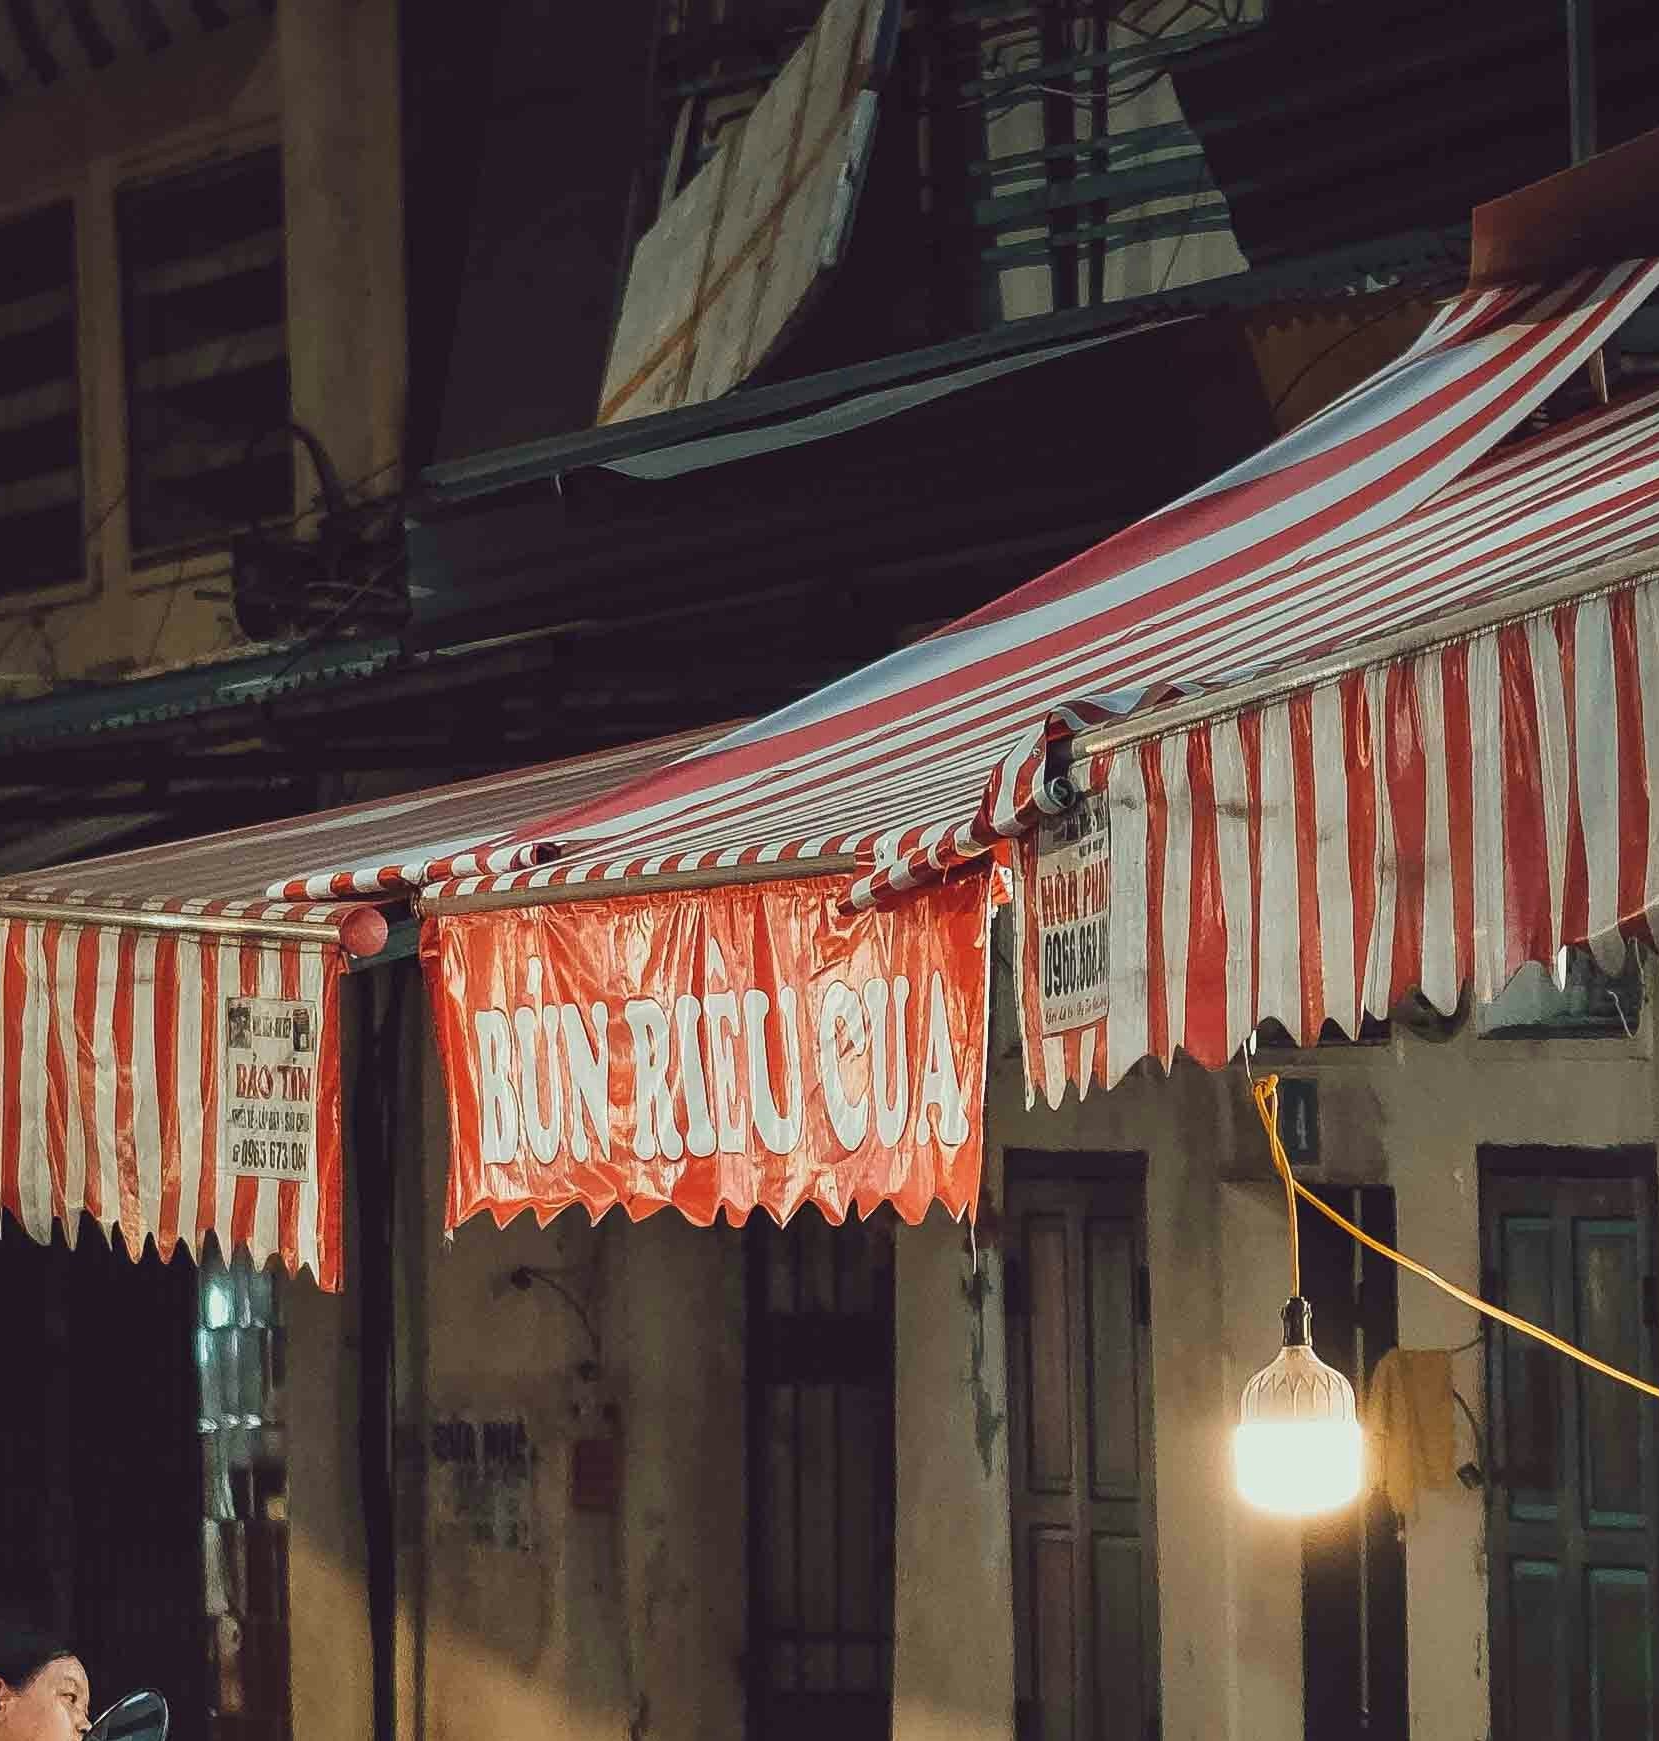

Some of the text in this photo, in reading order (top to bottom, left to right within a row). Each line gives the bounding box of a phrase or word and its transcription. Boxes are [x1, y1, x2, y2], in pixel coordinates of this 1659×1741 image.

[474, 936, 968, 1165] BÚN RIÊU CUA
